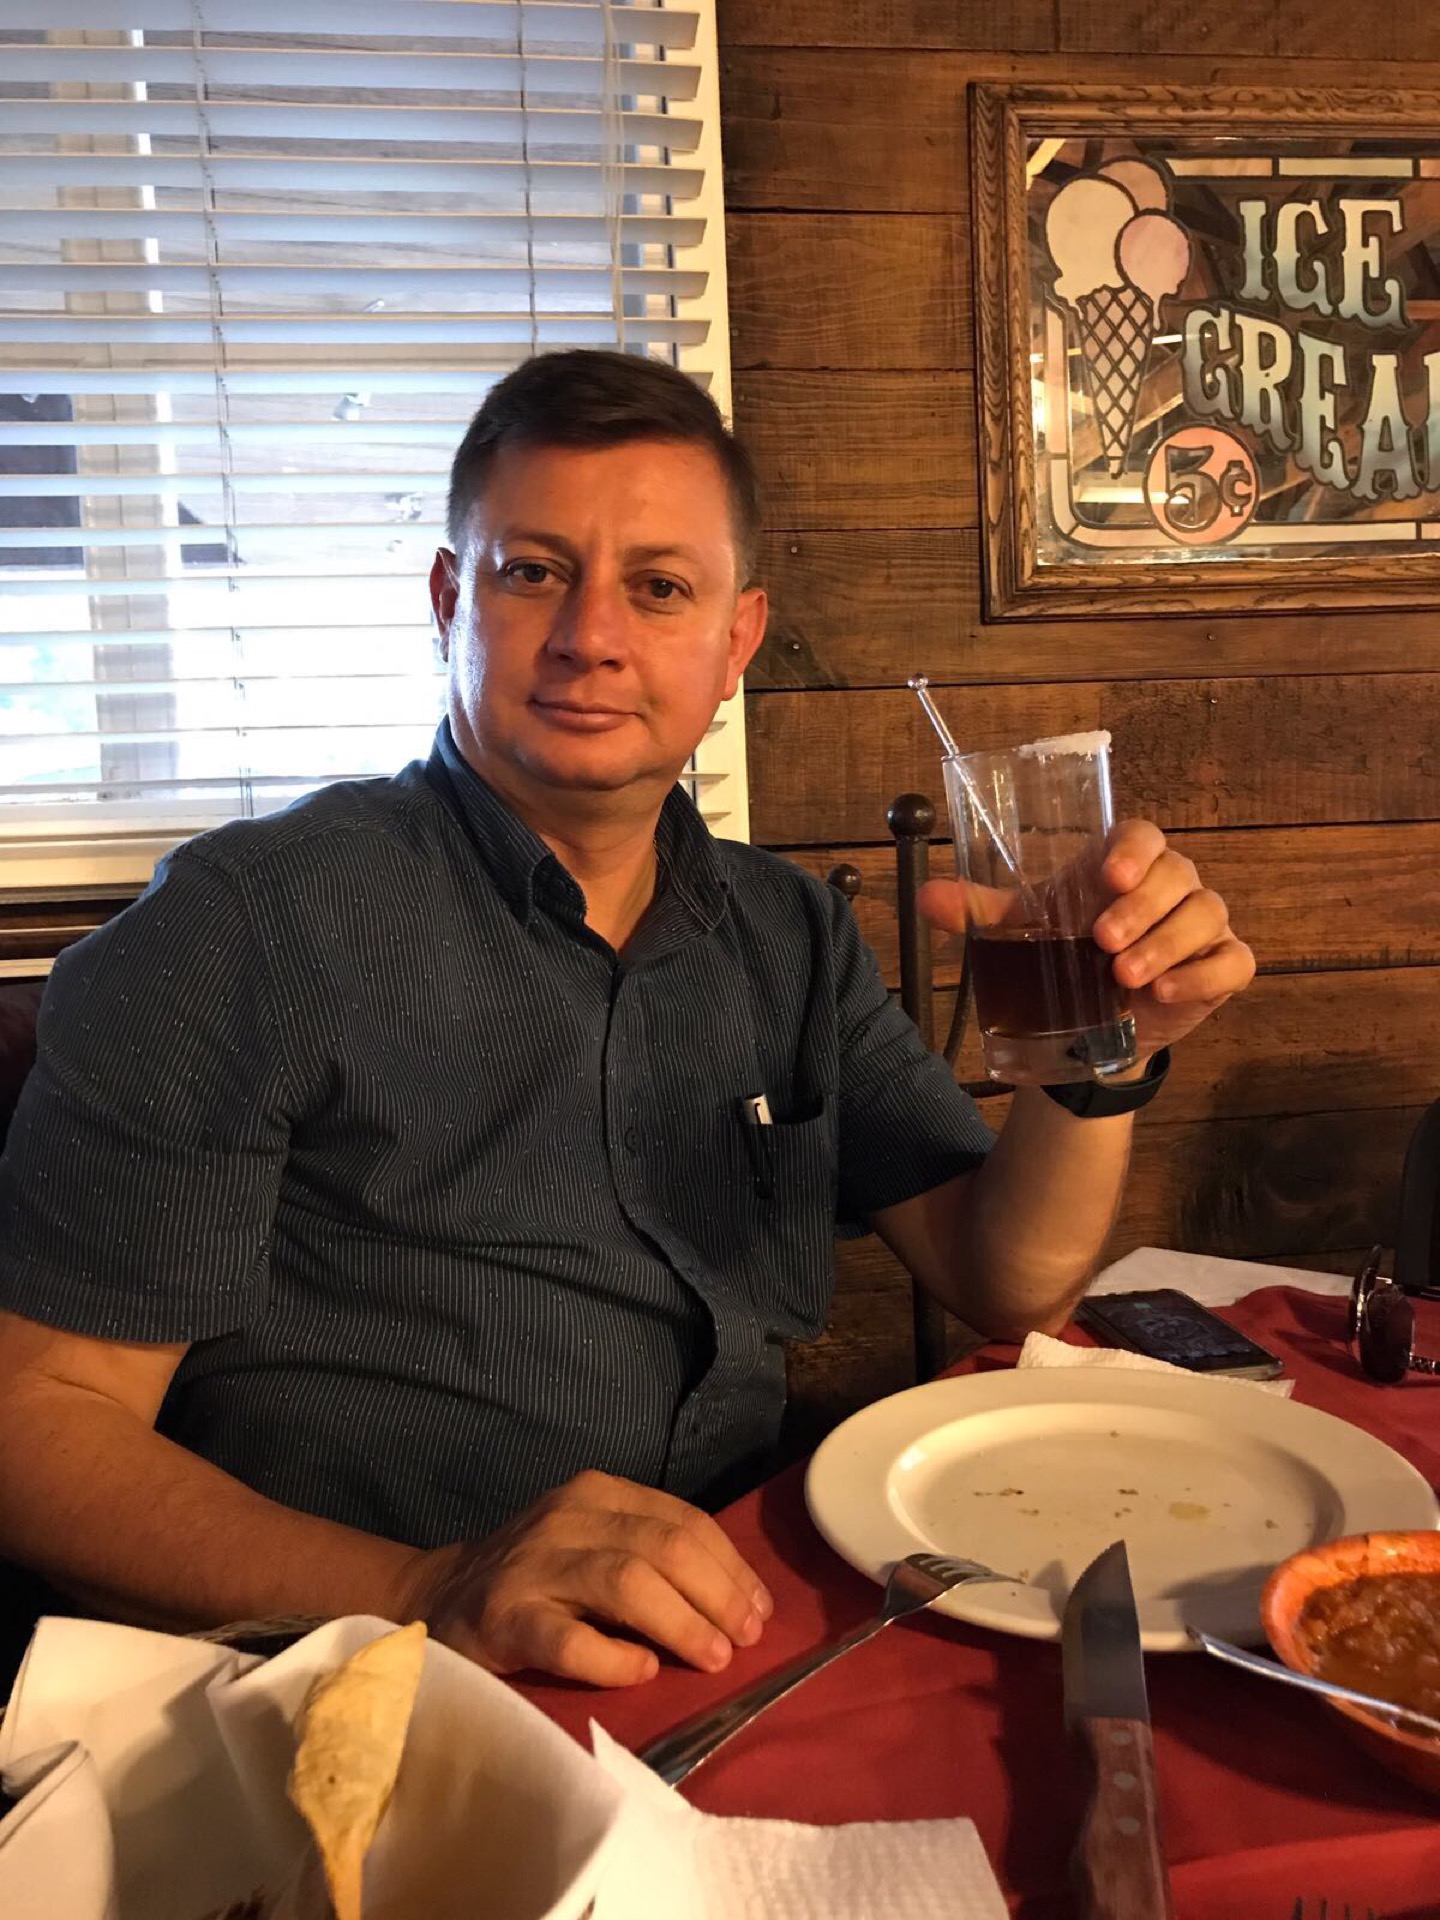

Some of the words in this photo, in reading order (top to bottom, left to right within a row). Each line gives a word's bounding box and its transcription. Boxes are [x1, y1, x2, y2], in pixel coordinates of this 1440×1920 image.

[1238, 198, 1406, 328] ICE
[1184, 307, 1440, 499] CREA
[1163, 444, 1253, 531] 5¢
